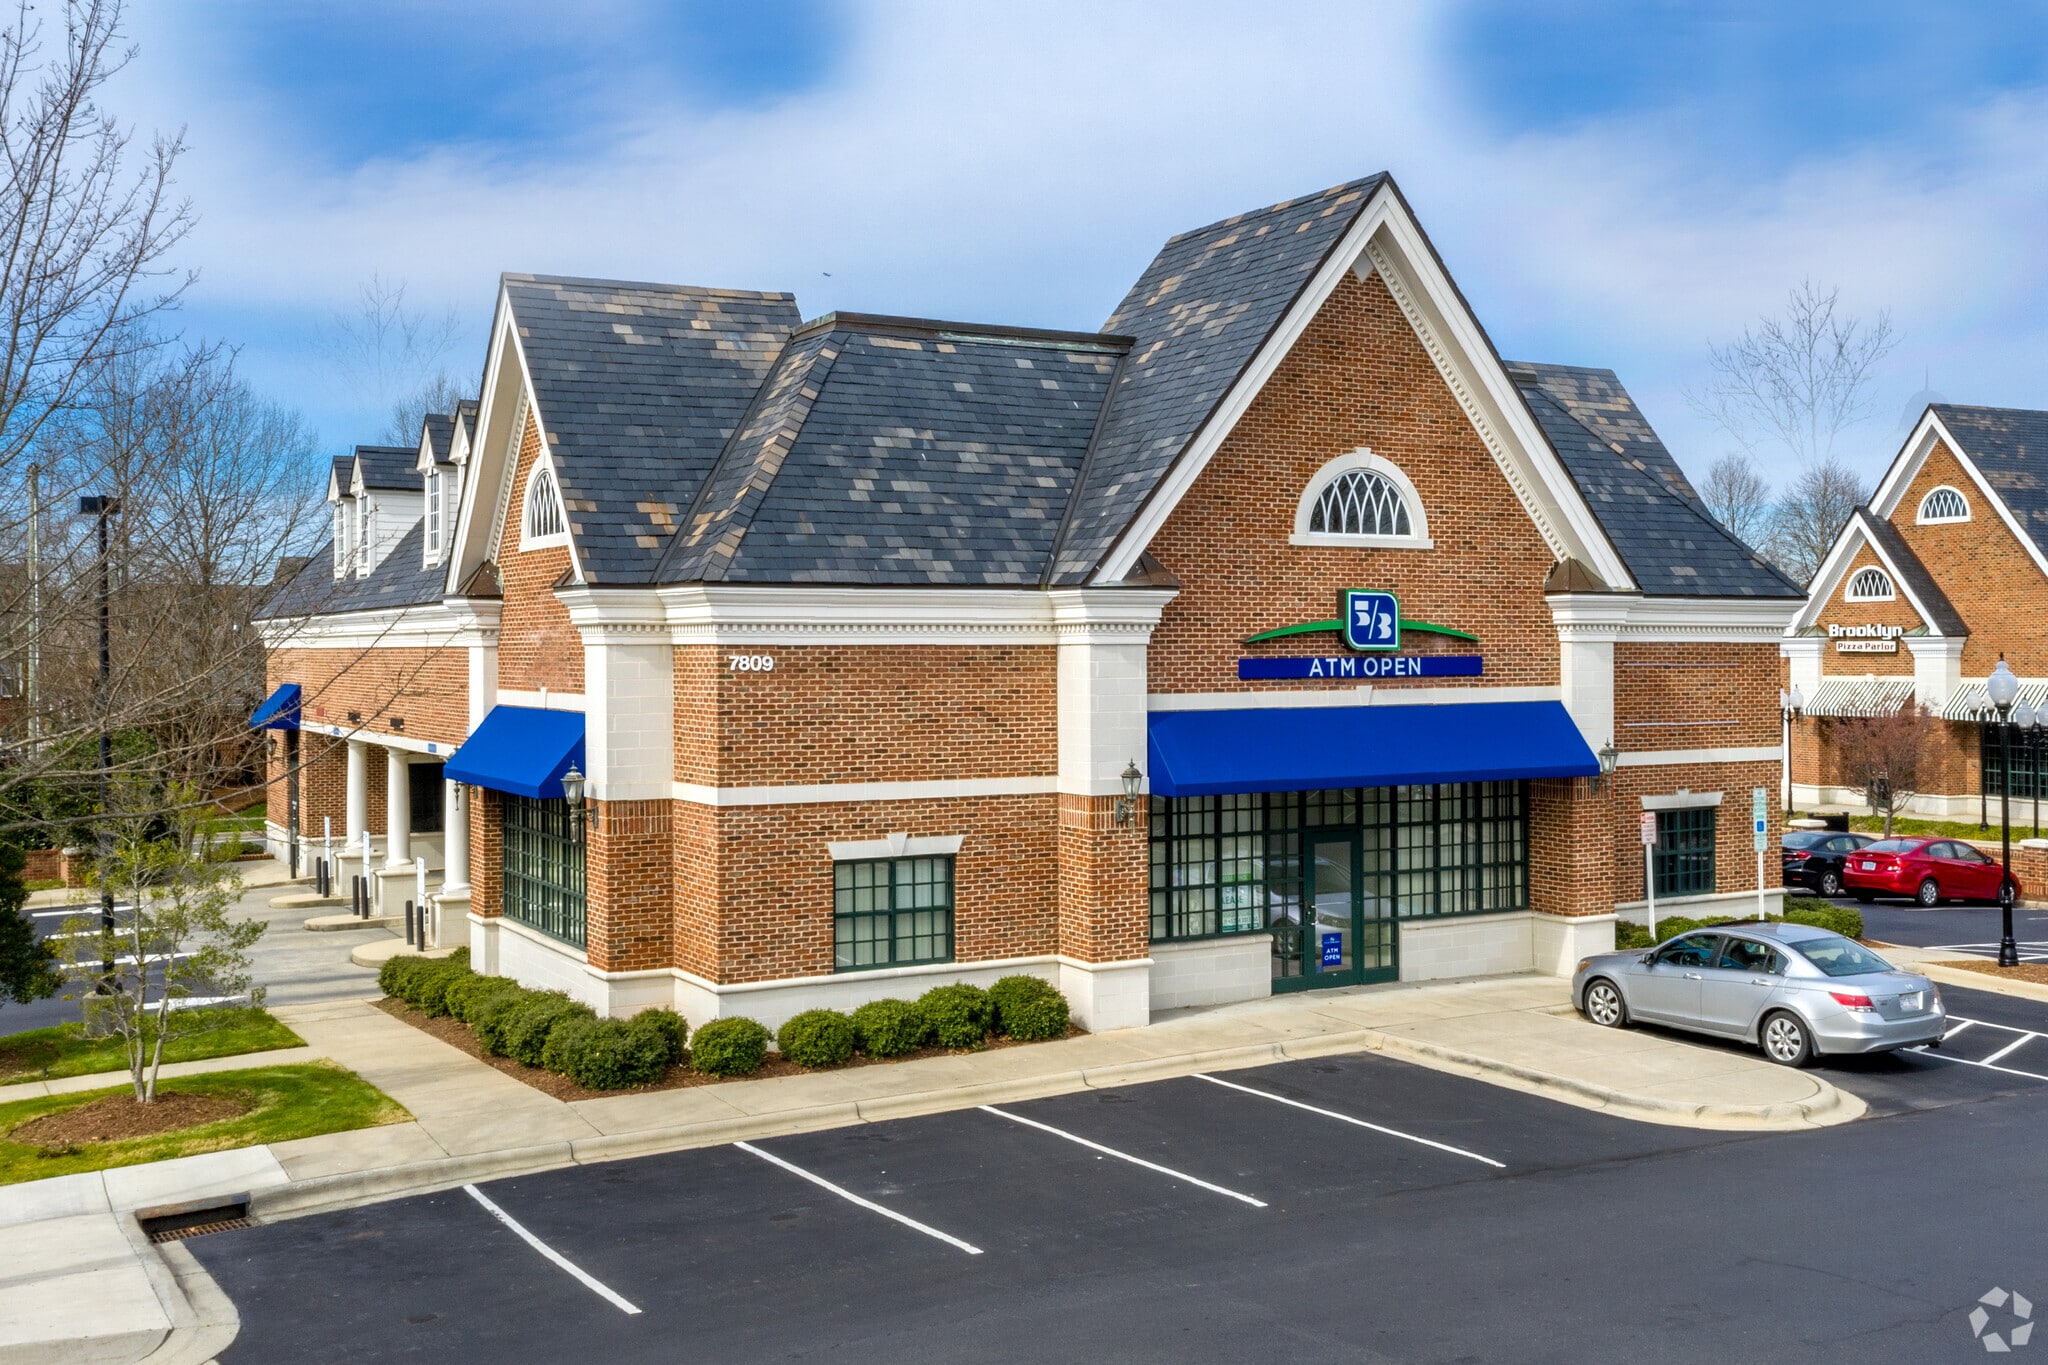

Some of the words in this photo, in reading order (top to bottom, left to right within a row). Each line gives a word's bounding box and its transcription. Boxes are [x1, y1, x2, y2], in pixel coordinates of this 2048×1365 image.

[1828, 623, 1903, 640] Brooklyn
[1837, 642, 1863, 650] Pizza
[1865, 642, 1895, 651] Parlor
[728, 655, 774, 671] 7809
[1309, 658, 1355, 677] ATM
[1363, 657, 1422, 677] OPEN
